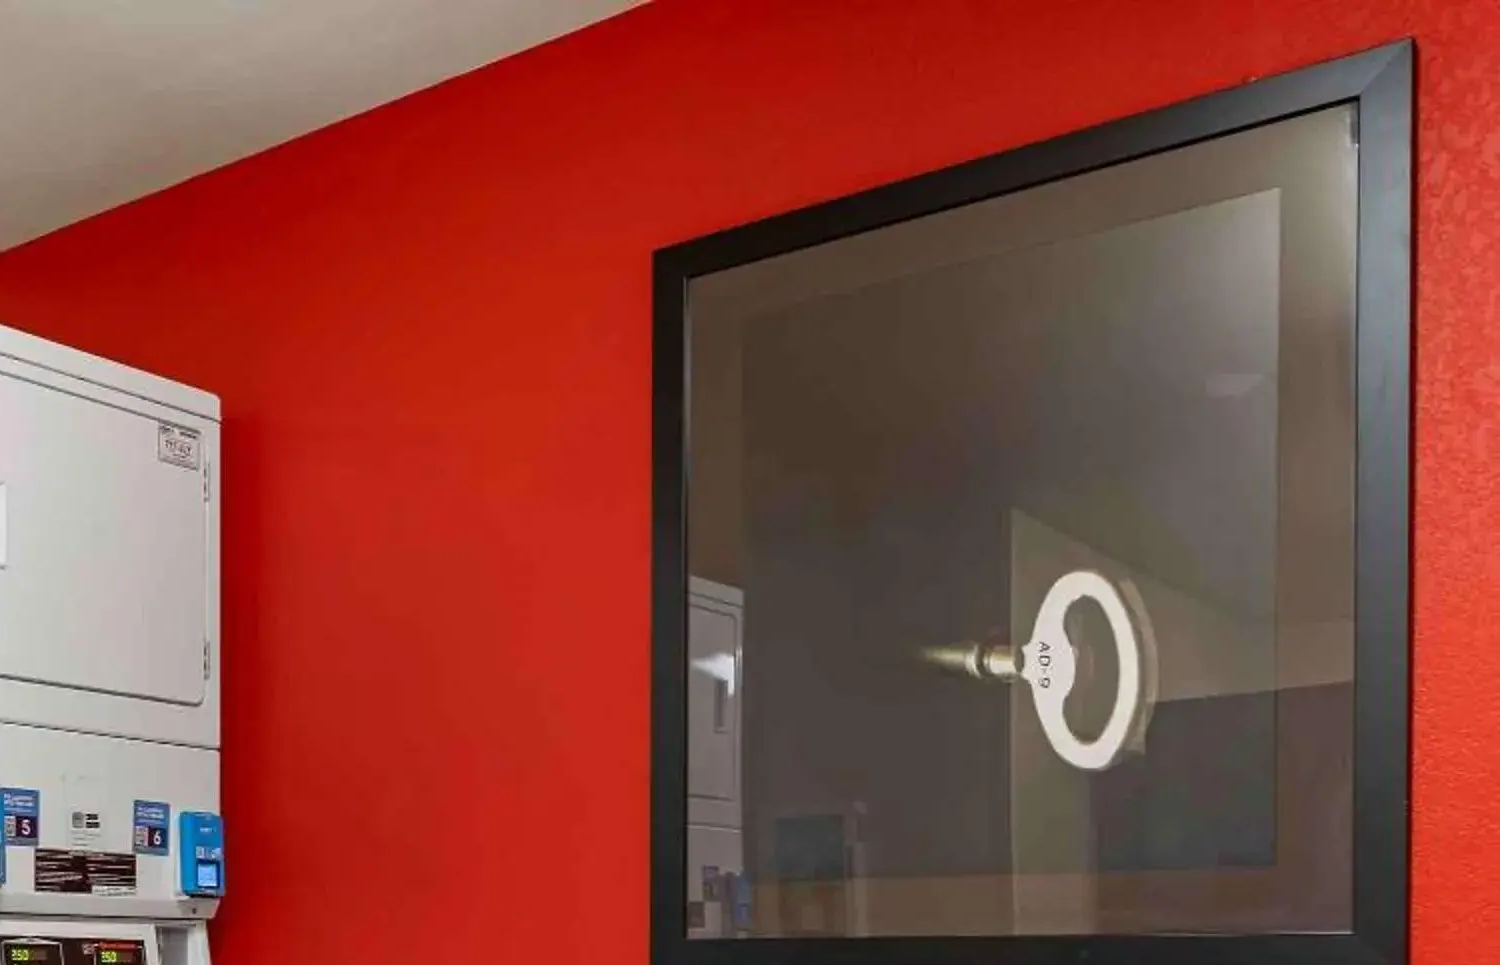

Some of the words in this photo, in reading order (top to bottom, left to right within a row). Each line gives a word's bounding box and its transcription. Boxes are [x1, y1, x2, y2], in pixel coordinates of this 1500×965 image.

[1037, 640, 1052, 689] AD-9
[21, 819, 31, 835] 5
[153, 829, 162, 846] 6
